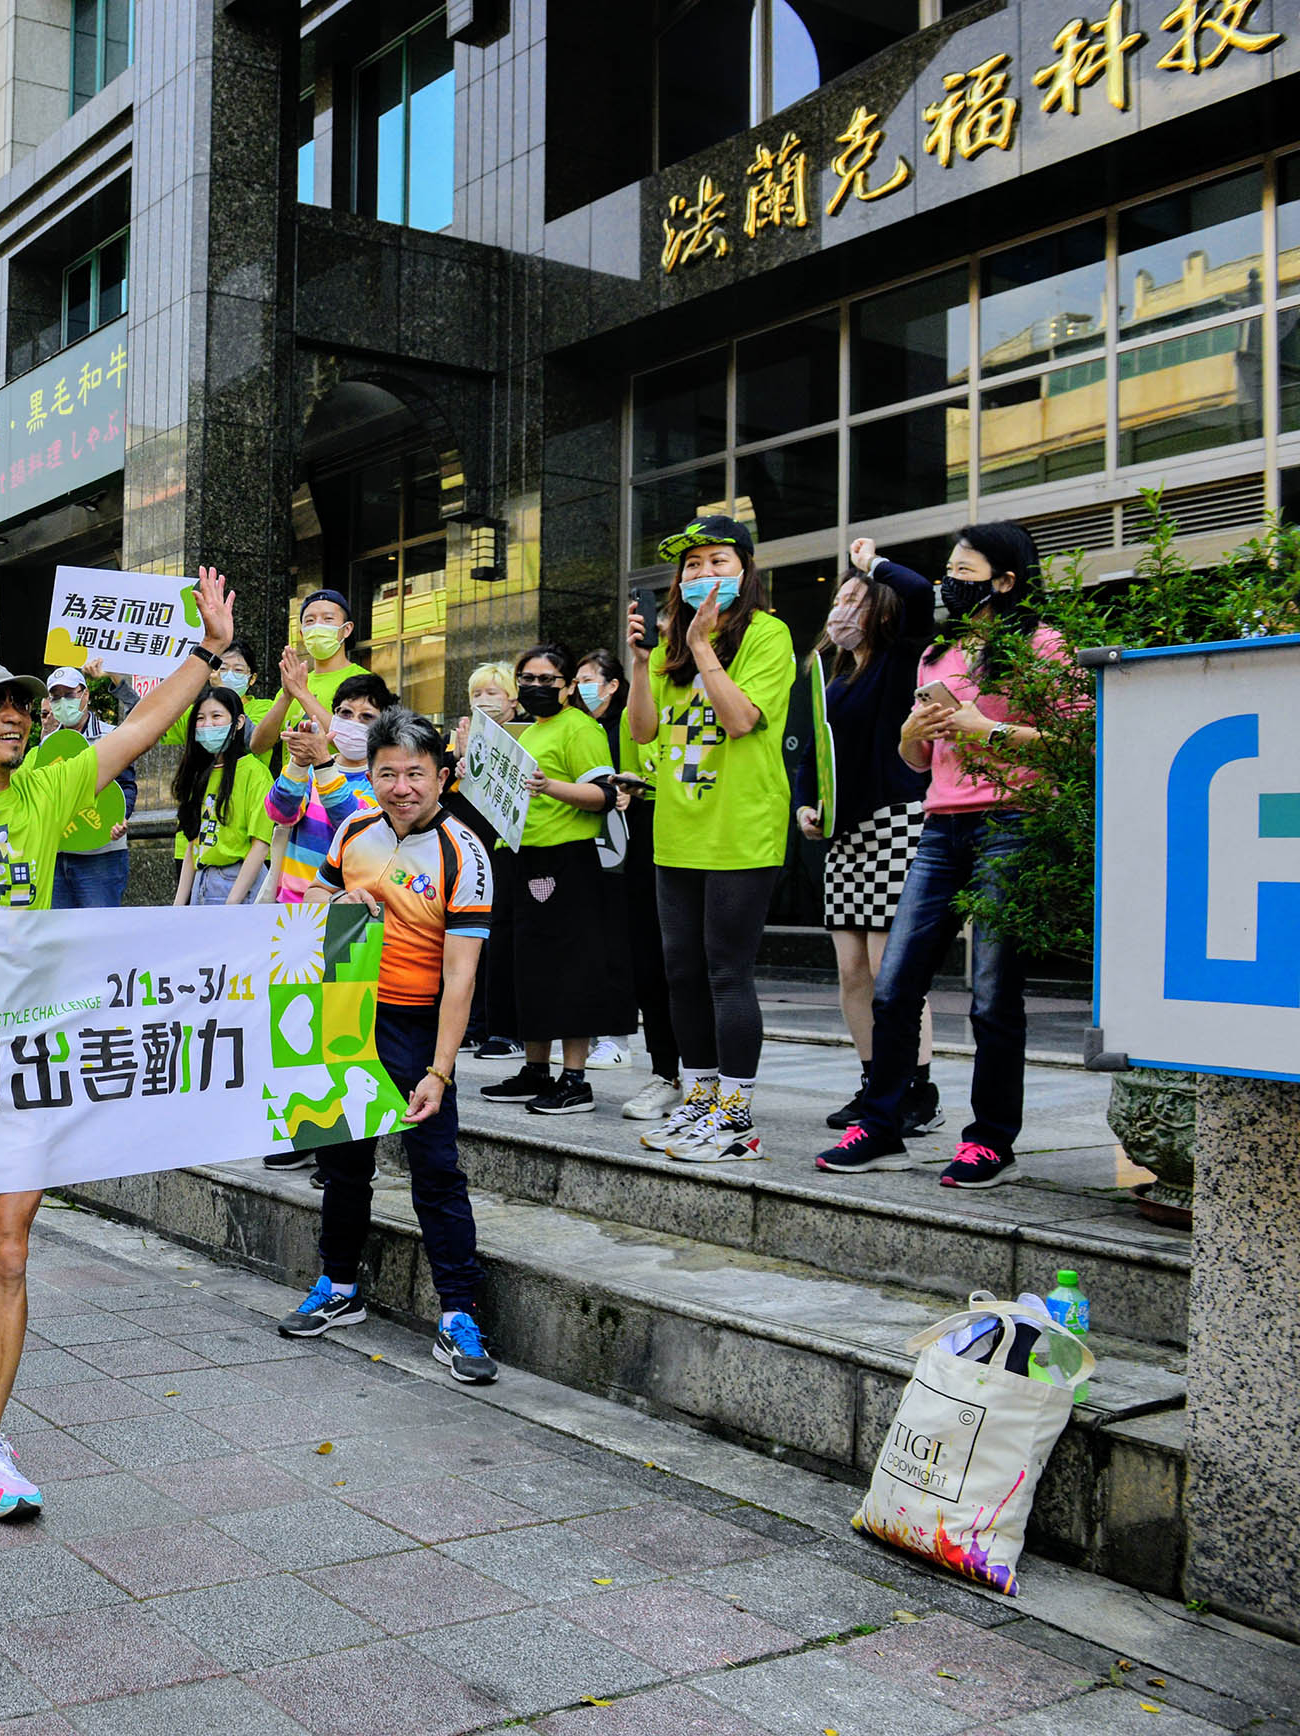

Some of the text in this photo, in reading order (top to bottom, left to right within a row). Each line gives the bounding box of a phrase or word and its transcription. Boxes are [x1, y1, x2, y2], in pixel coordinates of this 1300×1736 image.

[660, 0, 1284, 273] 法蘭克福科技
[74, 627, 200, 657] 跑出善動力
[468, 841, 485, 900] GIANT
[32, 995, 101, 1022] CHALLENGE
[894, 1421, 944, 1466] TIGI
[887, 1452, 948, 1487] copyright
